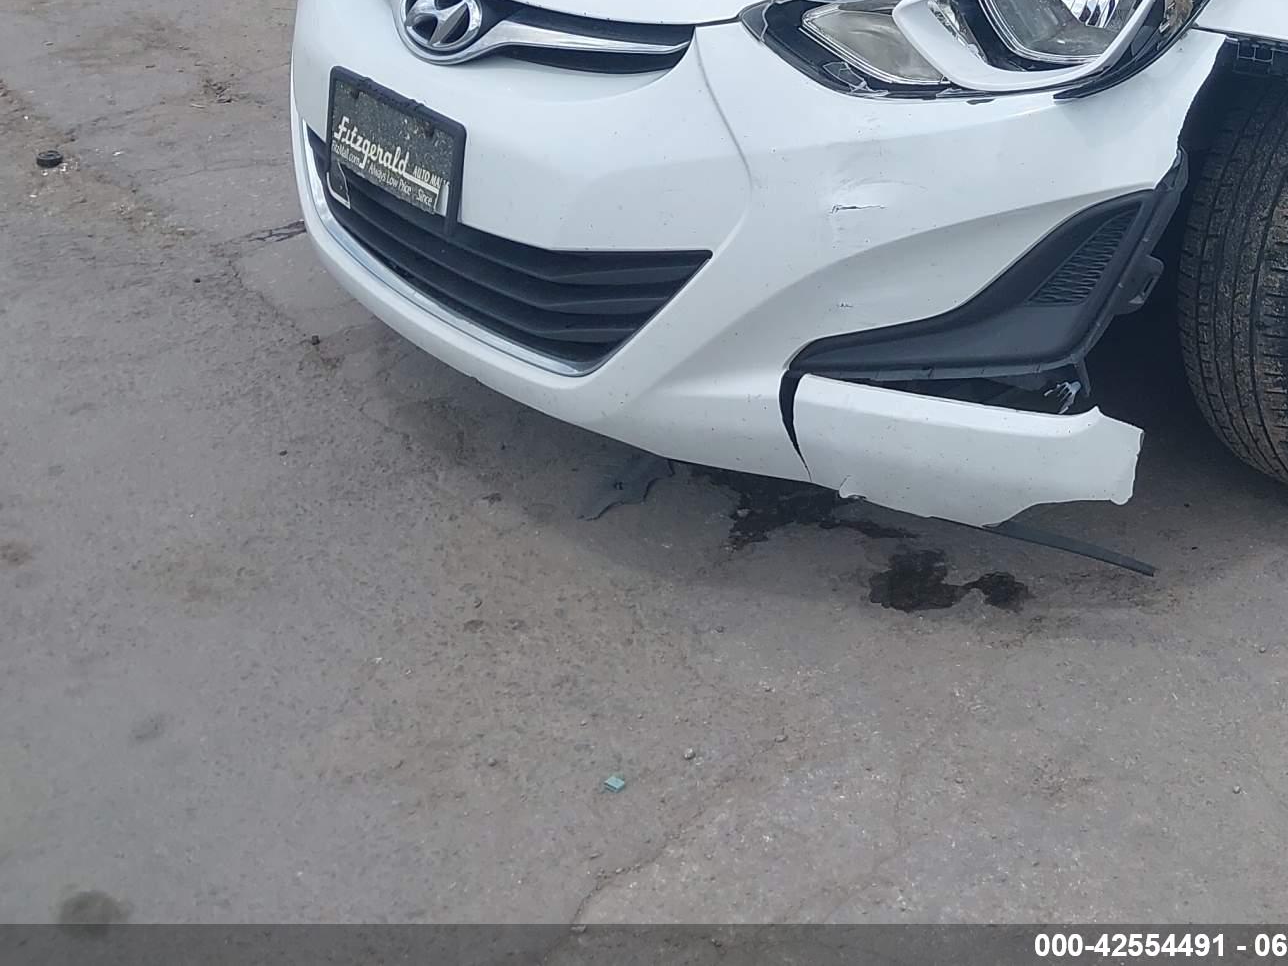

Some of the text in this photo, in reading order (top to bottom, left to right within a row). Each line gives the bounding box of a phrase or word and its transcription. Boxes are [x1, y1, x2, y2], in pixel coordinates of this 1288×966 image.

[334, 115, 409, 176] Fitzgerald
[413, 165, 430, 182] AUTO
[386, 171, 398, 187] Low
[416, 188, 433, 206] Since
